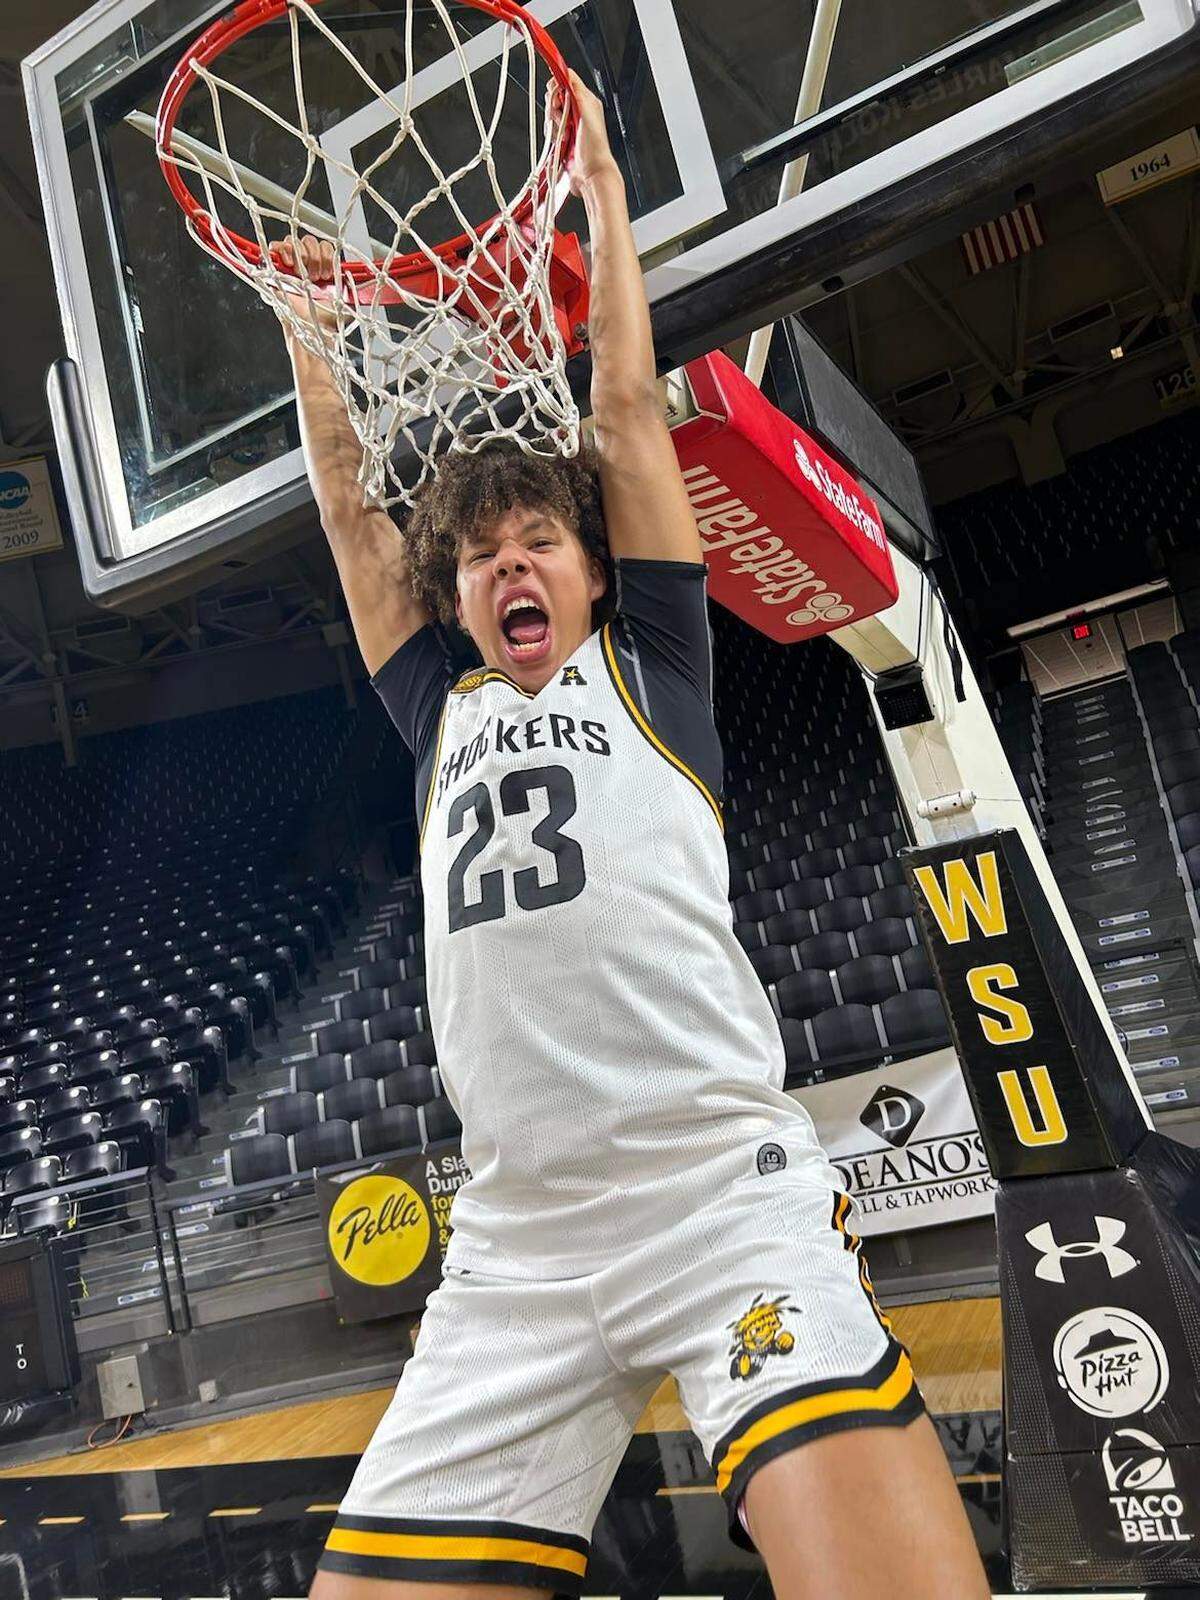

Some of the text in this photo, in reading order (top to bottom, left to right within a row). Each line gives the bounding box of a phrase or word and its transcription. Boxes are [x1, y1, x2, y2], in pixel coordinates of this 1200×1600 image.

[1131, 153, 1170, 181] 1964
[3, 528, 40, 549] 2009
[447, 764, 587, 934] 23
[875, 1096, 912, 1133] D
[425, 1156, 468, 1178] A Sla
[885, 1194, 900, 1209] &
[901, 1176, 999, 1207] TAPWORK
[337, 1192, 421, 1261] Pella
[1095, 1369, 1141, 1398] Hut
[1109, 1494, 1185, 1519] TACO
[1120, 1518, 1191, 1543] BELL
